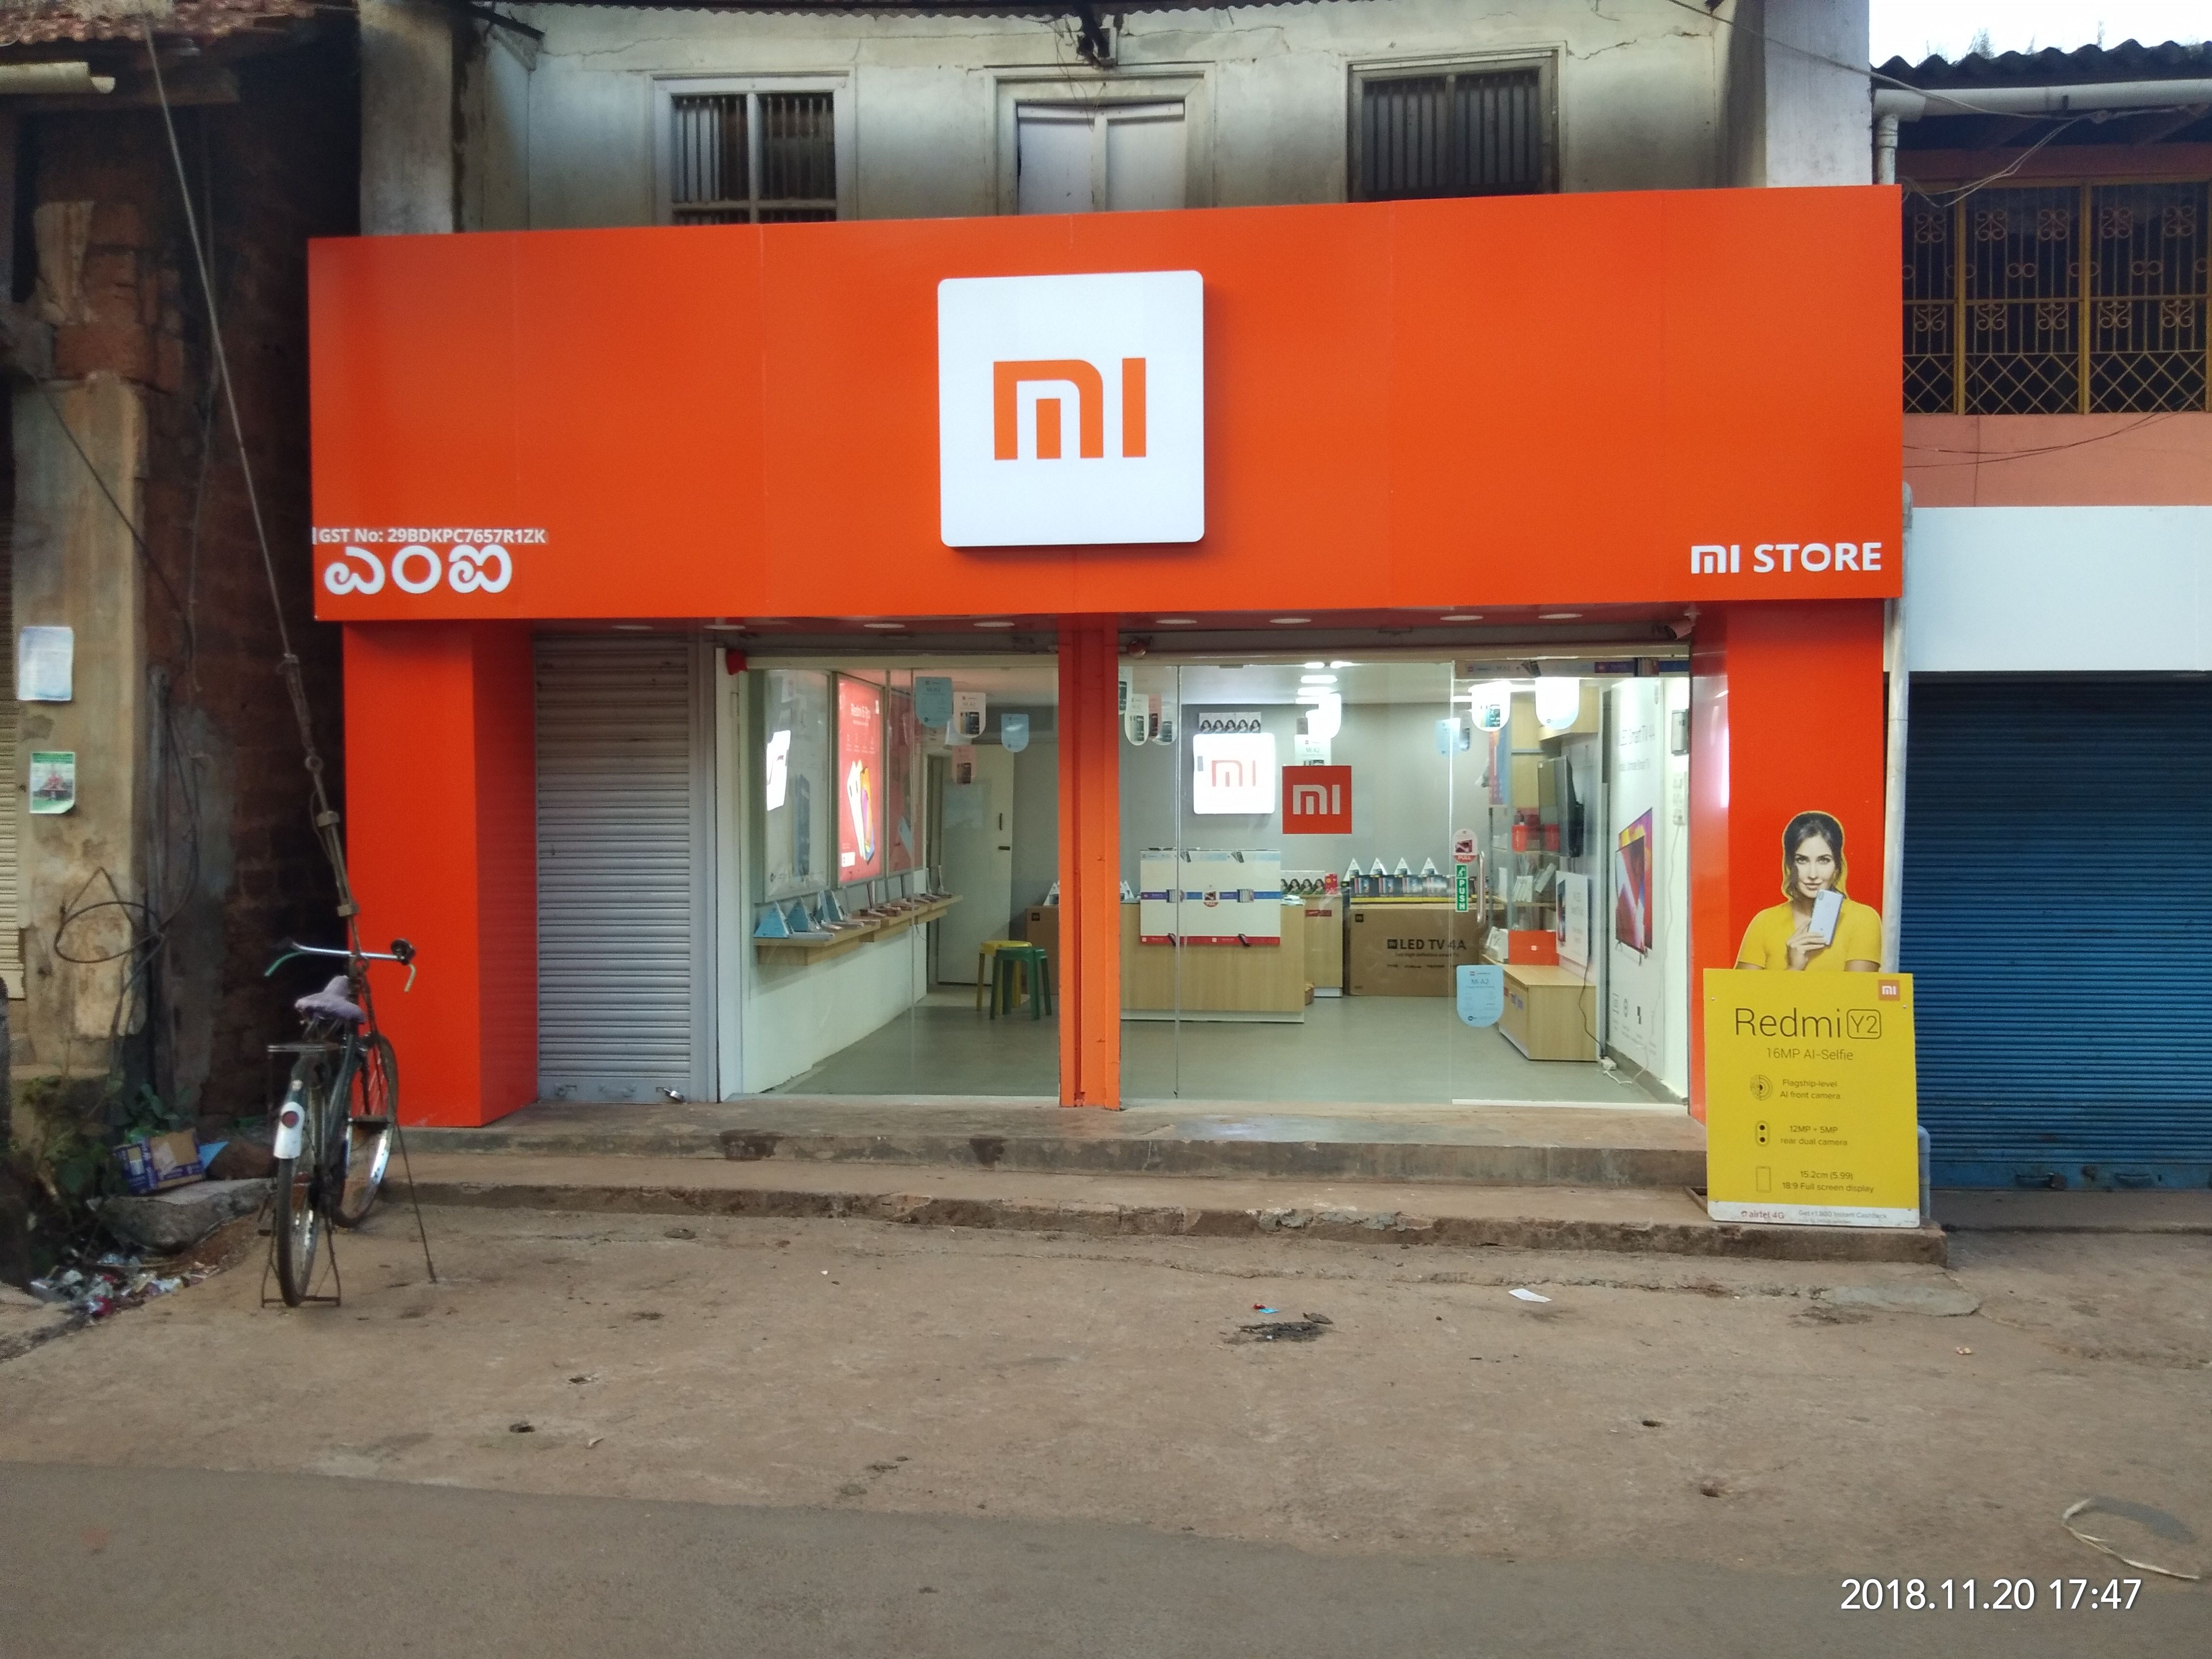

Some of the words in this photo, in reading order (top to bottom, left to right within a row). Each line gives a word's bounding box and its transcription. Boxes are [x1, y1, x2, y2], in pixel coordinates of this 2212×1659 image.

[320, 529, 349, 543] GST
[355, 529, 383, 543] No:
[1753, 542, 1882, 573] STORE
[1400, 939, 1424, 950] LED
[1428, 939, 1445, 950] TV
[1735, 1007, 1840, 1038] Redmi
[1851, 1015, 1878, 1034] Y2
[1767, 1048, 1800, 1059] 16MP
[1803, 1049, 1853, 1060] AI-Selfie
[1782, 1079, 1838, 1088] Flagship-level
[1846, 1185, 1874, 1193] display
